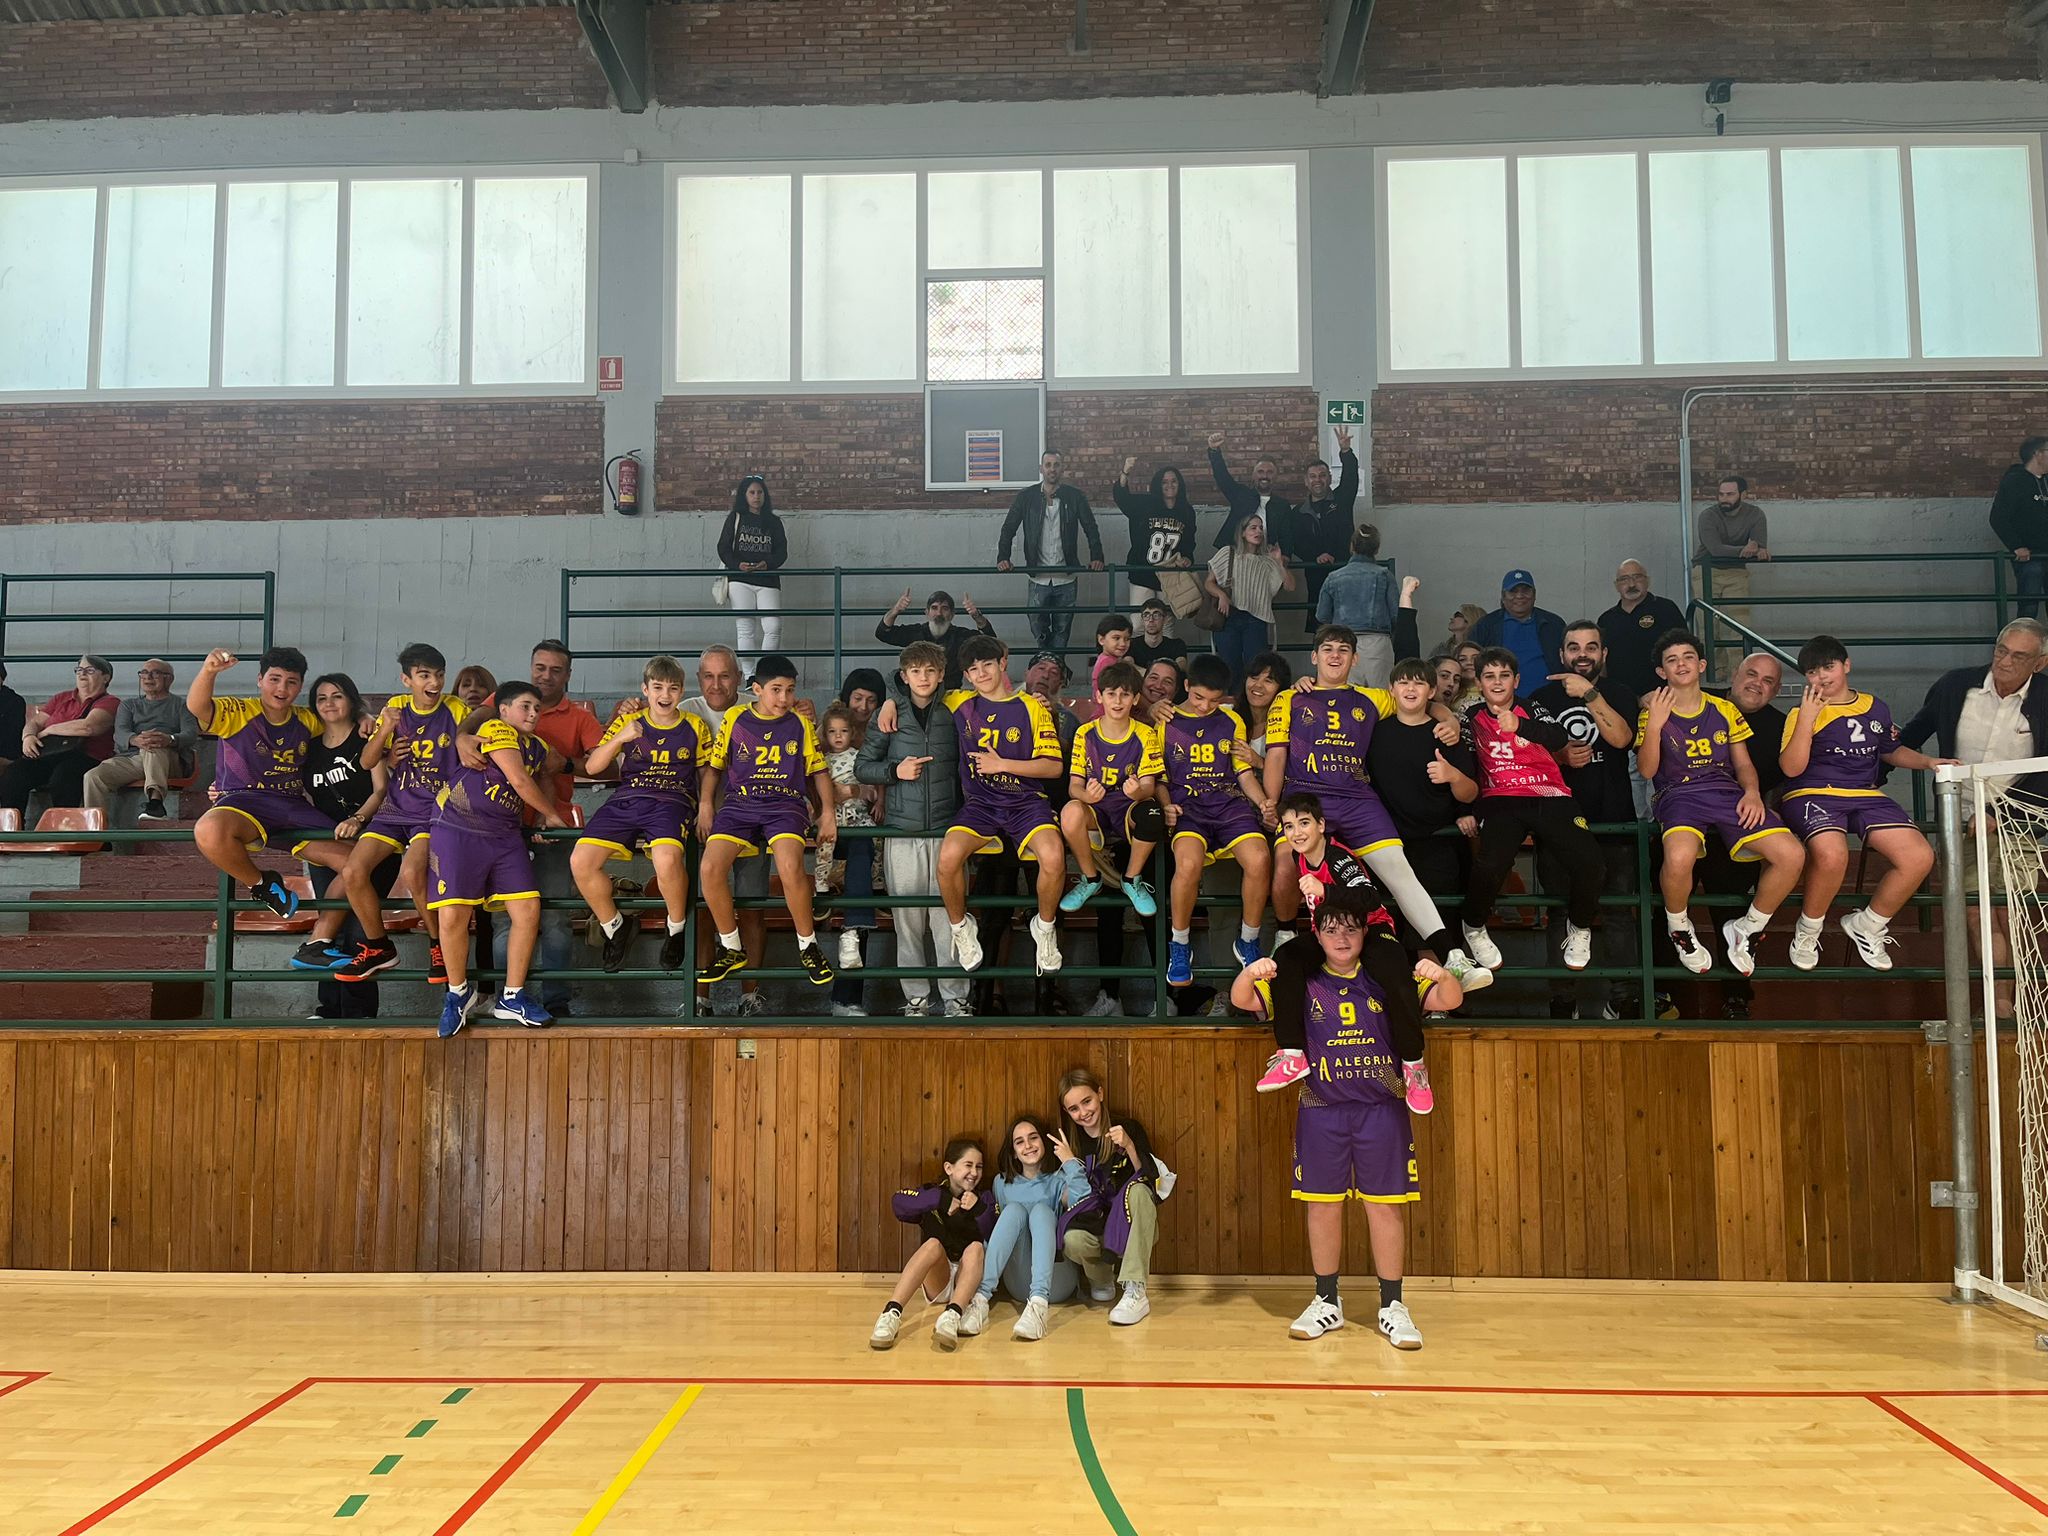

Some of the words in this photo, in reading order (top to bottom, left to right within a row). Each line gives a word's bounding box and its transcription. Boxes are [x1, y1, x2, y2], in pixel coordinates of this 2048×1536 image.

[738, 532, 772, 545] AMOUR
[1147, 531, 1181, 564] 87
[1327, 710, 1341, 730] 3
[978, 727, 1000, 750] 21
[1847, 718, 1867, 743] 2
[650, 749, 671, 763] 14
[755, 745, 781, 766] 24
[1190, 743, 1215, 763] 98
[1489, 741, 1515, 759] 25
[1685, 738, 1713, 758] 28
[1322, 753, 1363, 765] ALEGRI
[1101, 766, 1119, 786] 15
[1339, 1002, 1357, 1026] 9
[1327, 1037, 1375, 1047] CALELLA
[1337, 1029, 1363, 1037] UEH
[1335, 1055, 1393, 1068] ALEGRIA
[1336, 1069, 1385, 1080] HOTELS
[1408, 1159, 1418, 1182] 9
